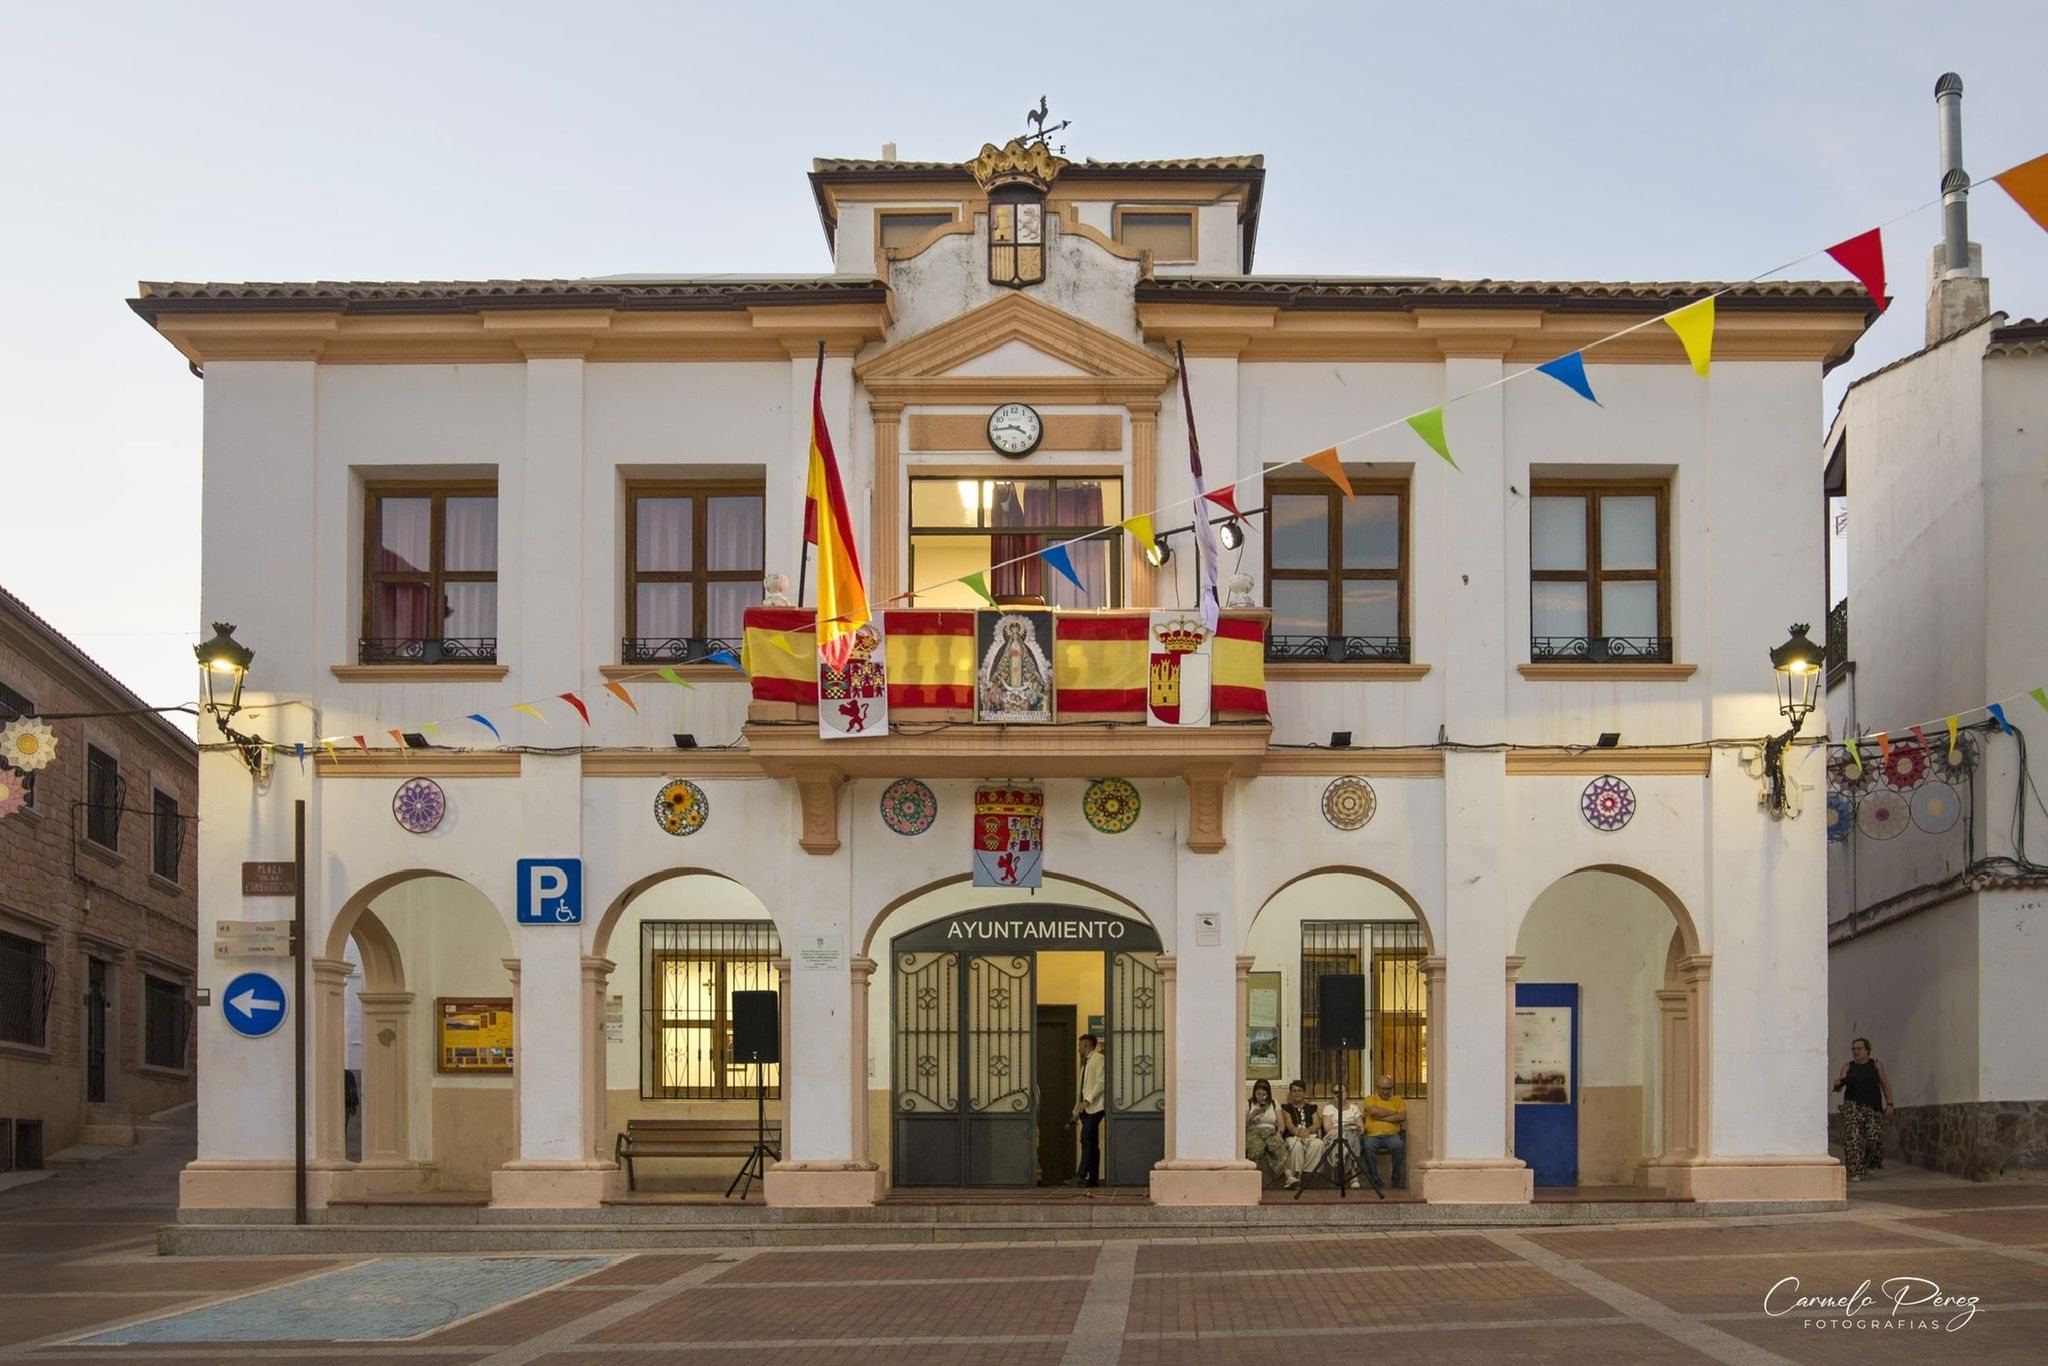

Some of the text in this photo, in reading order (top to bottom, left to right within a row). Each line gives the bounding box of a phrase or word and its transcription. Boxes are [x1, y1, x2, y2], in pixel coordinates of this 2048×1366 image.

[1060, 145, 1066, 154] E
[257, 864, 281, 874] PLAZA
[531, 866, 568, 916] P
[947, 921, 1125, 939] AYUNTAMIENTO
